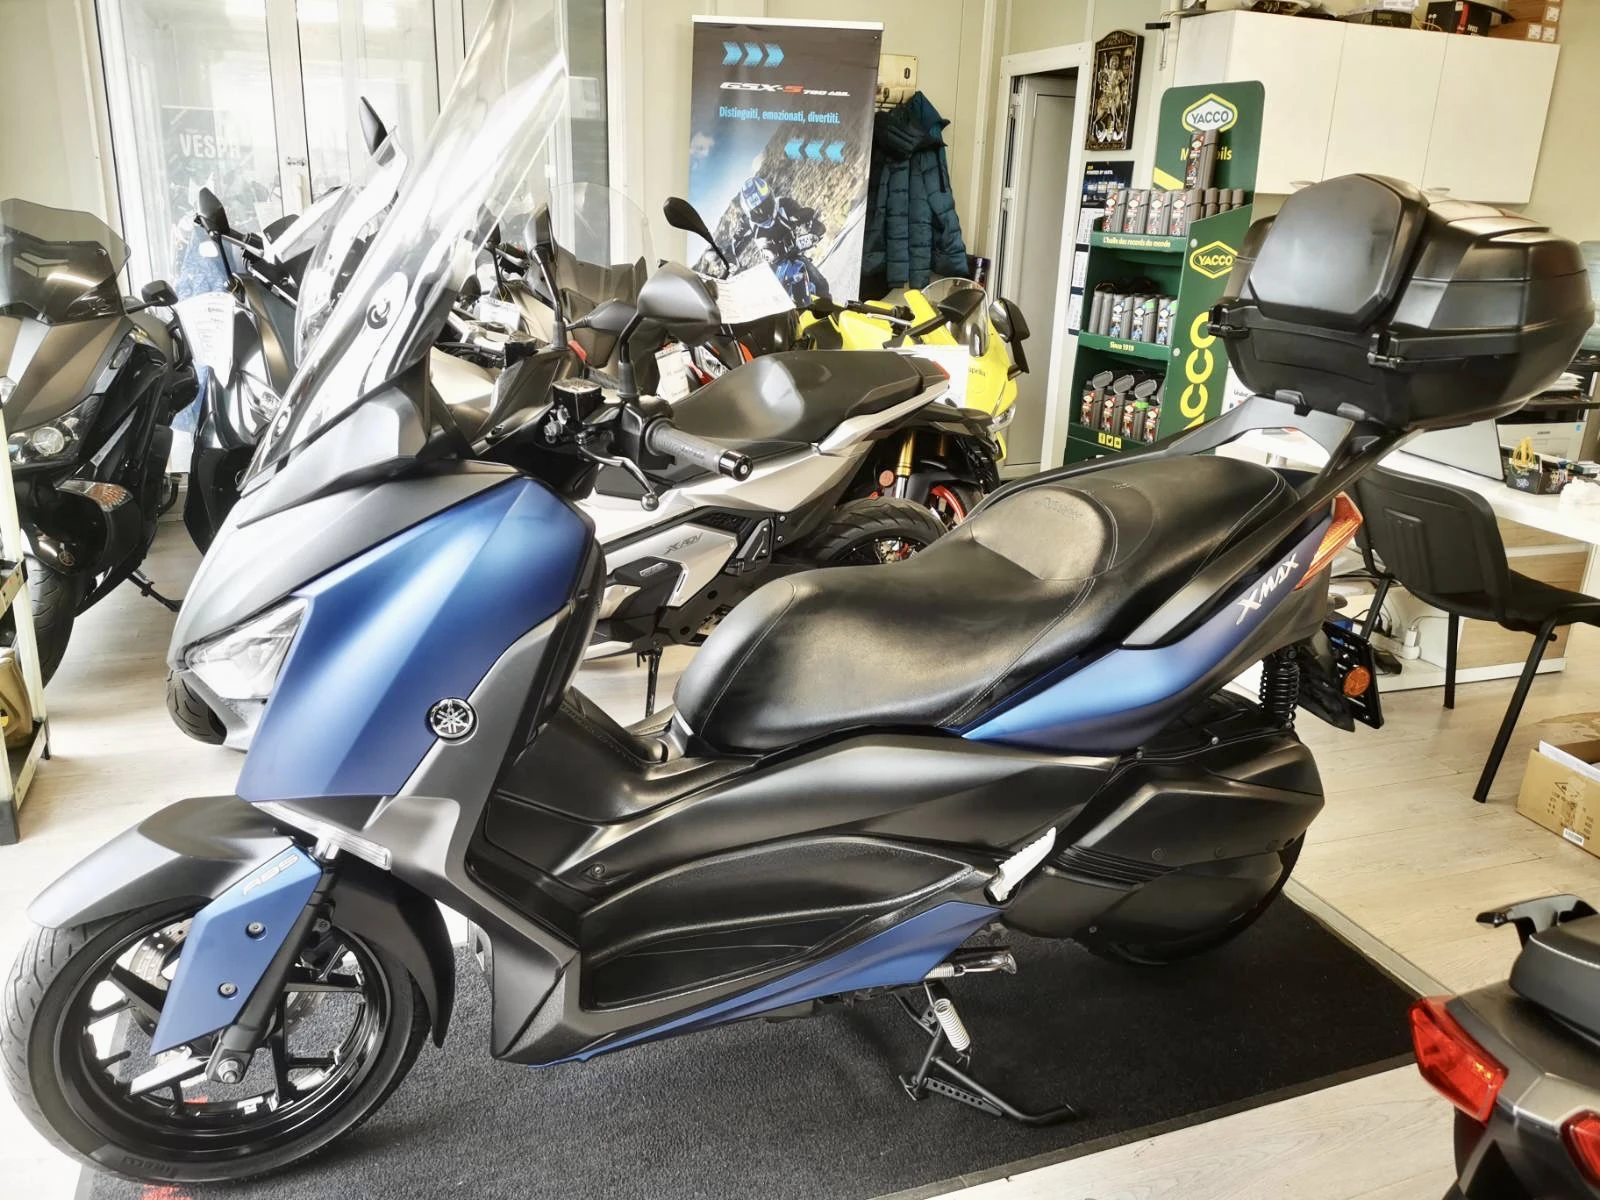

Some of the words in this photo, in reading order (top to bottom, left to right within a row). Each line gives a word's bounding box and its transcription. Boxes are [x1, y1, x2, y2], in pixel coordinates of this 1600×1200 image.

[719, 106, 760, 121] Distinguiti,
[762, 110, 806, 124] emozionati,
[808, 111, 841, 124] divertiti.
[1191, 110, 1229, 124] YACCO
[179, 133, 241, 159] VESPA
[1198, 253, 1233, 267] YACCO
